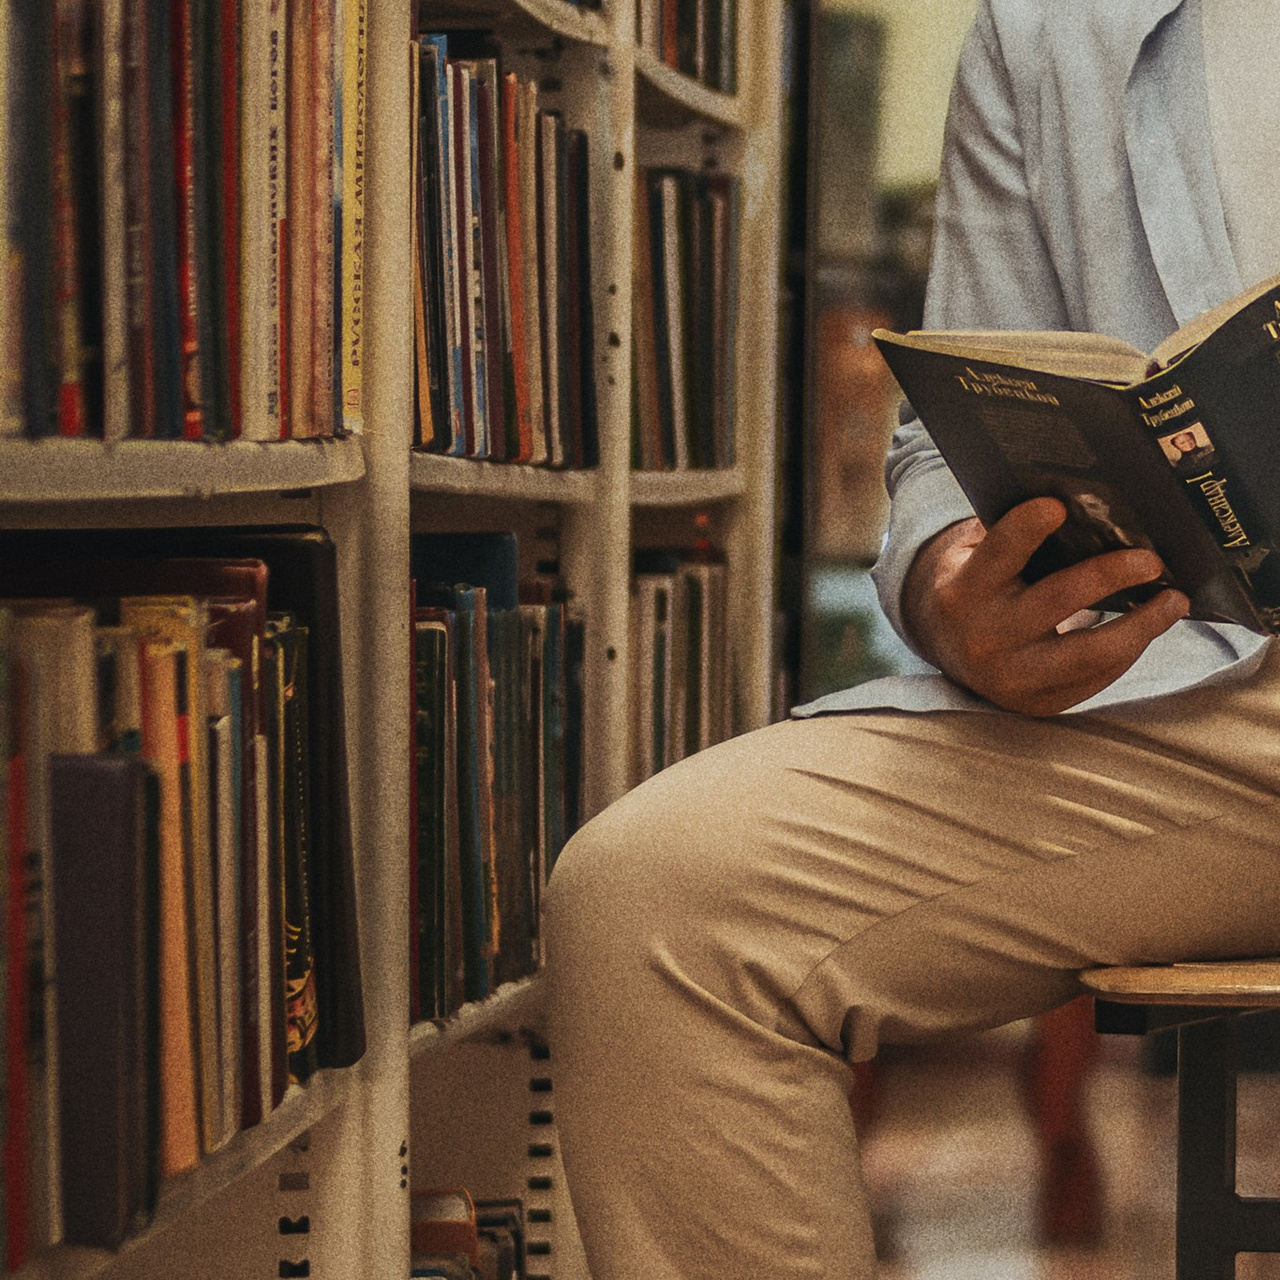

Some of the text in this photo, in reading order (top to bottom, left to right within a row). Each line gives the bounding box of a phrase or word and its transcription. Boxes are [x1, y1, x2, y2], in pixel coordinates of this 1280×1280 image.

[1139, 384, 1183, 410] Алексей
[1140, 398, 1196, 429] Трубецкой
[1186, 470, 1252, 549] Александр I
